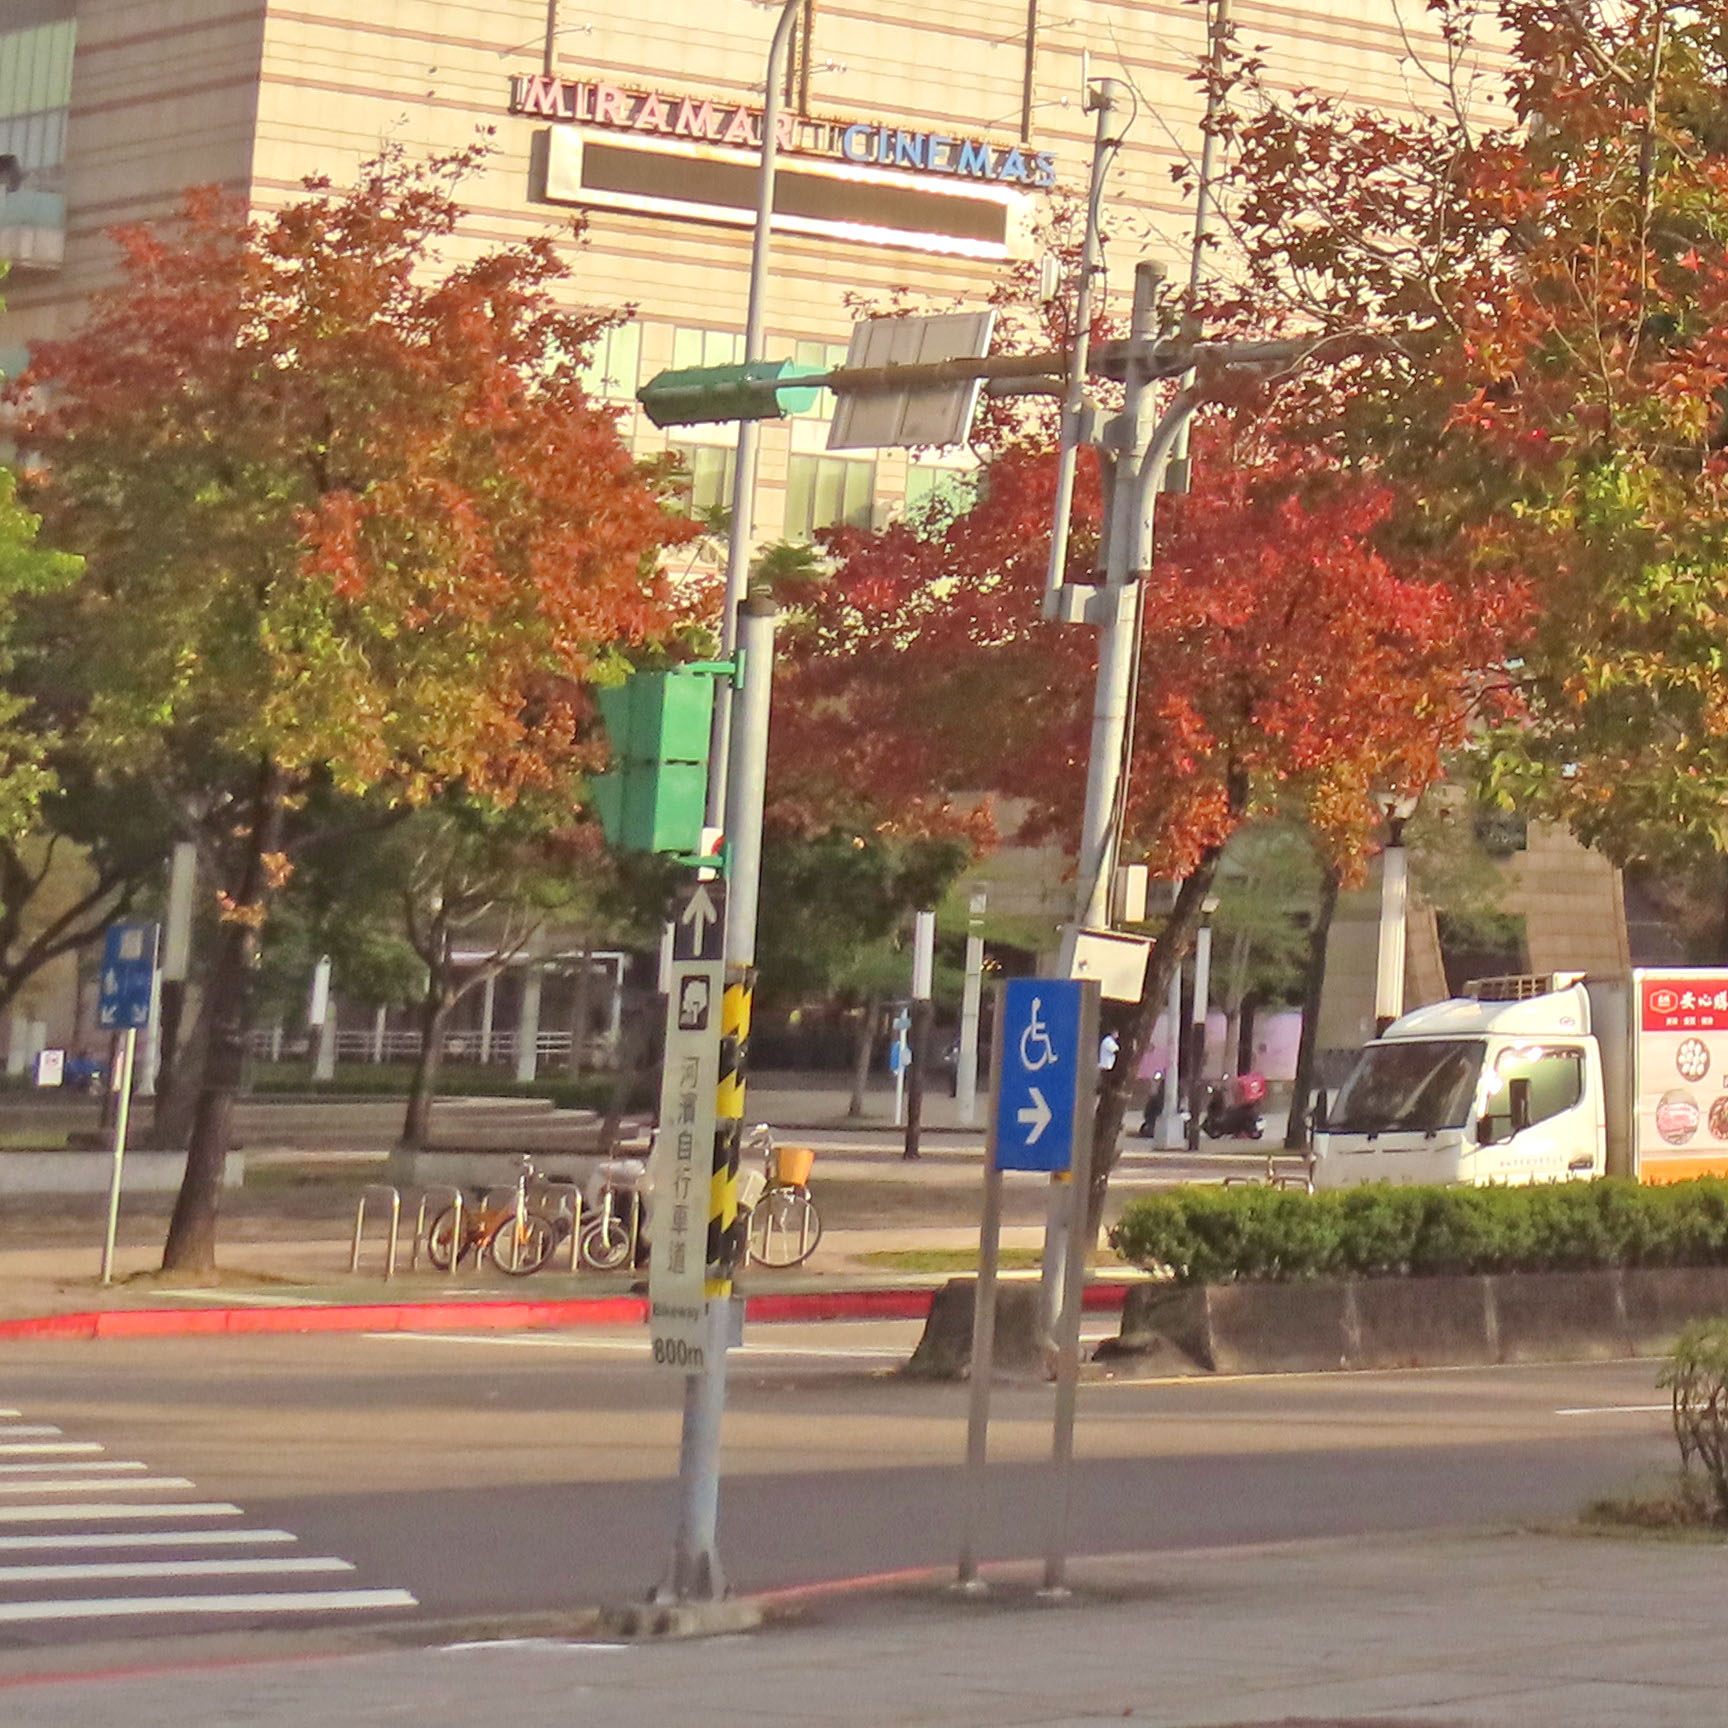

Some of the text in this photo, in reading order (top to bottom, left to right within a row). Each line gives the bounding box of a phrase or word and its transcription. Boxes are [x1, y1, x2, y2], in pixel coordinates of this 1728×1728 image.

[522, 75, 1058, 187] MIRAMAR CINEMAS
[654, 1337, 704, 1368] 800m
